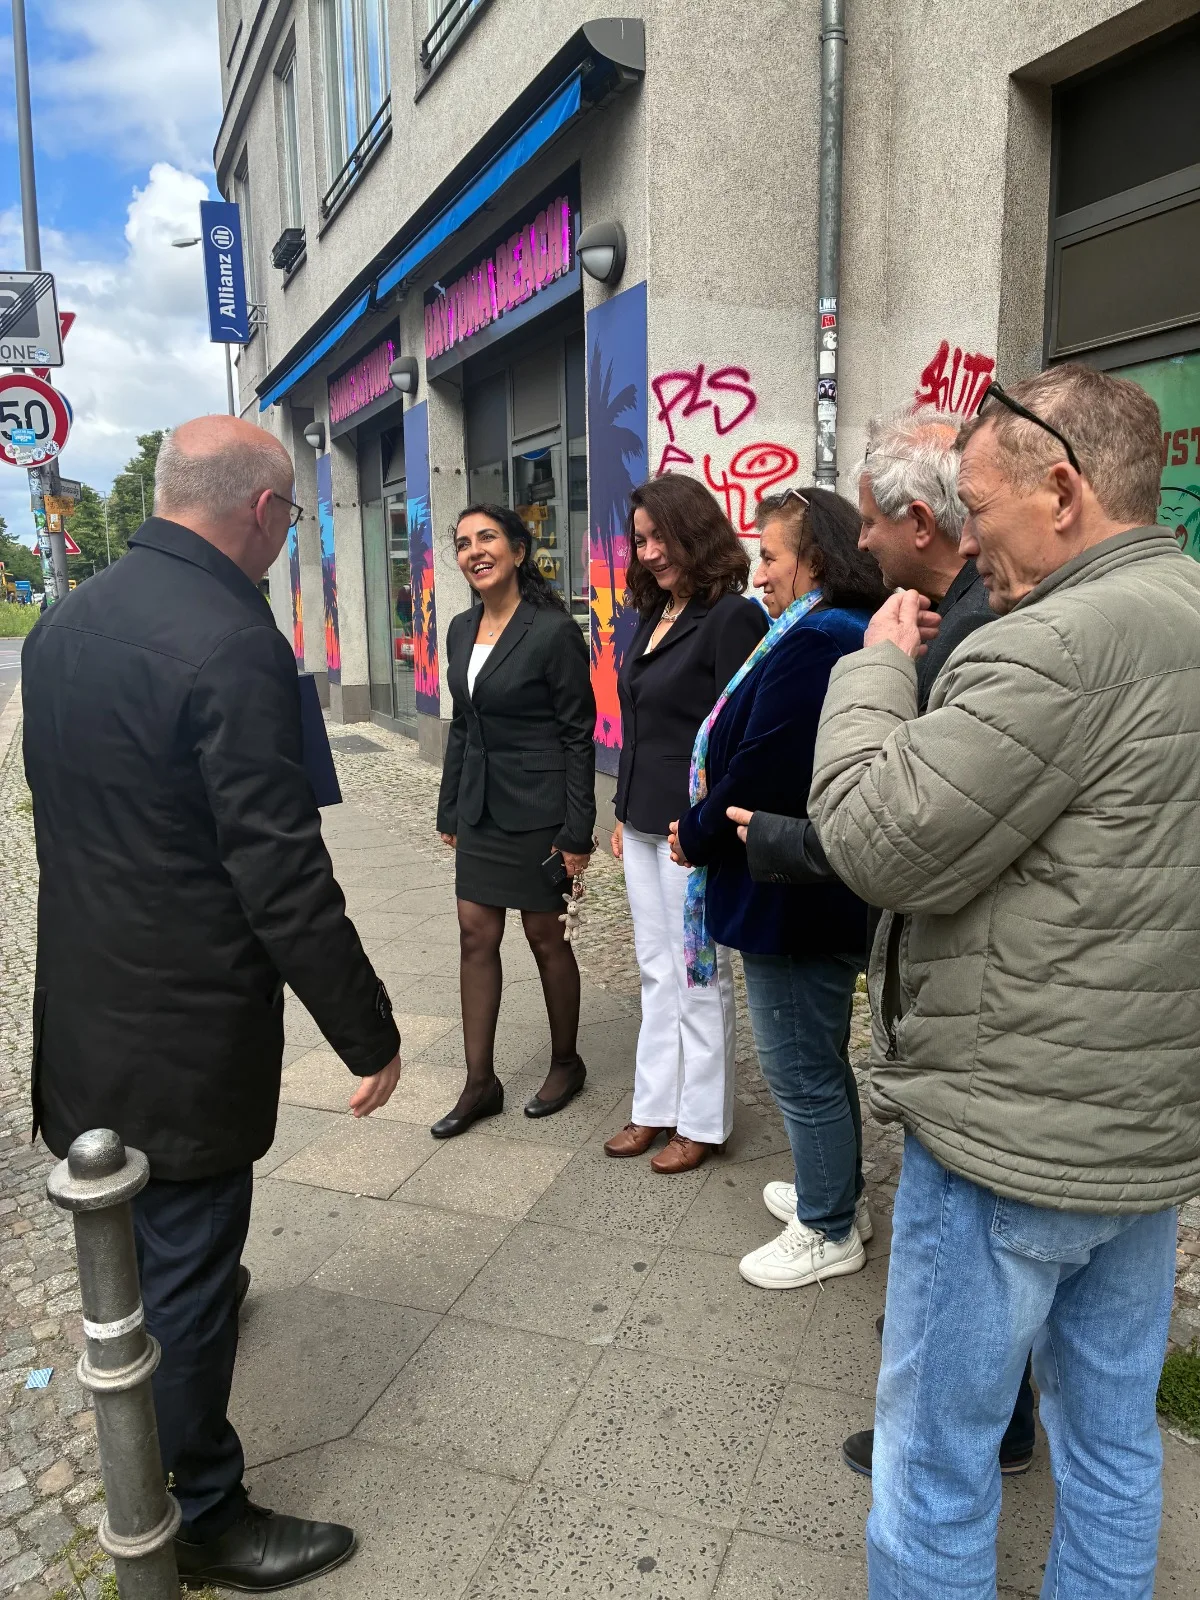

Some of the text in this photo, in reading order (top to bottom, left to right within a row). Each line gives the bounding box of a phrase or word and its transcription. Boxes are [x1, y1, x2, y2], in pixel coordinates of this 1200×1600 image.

[218, 253, 237, 319] Allianz
[424, 196, 569, 361] DAYTONA BEACH
[0, 399, 50, 440] 50
